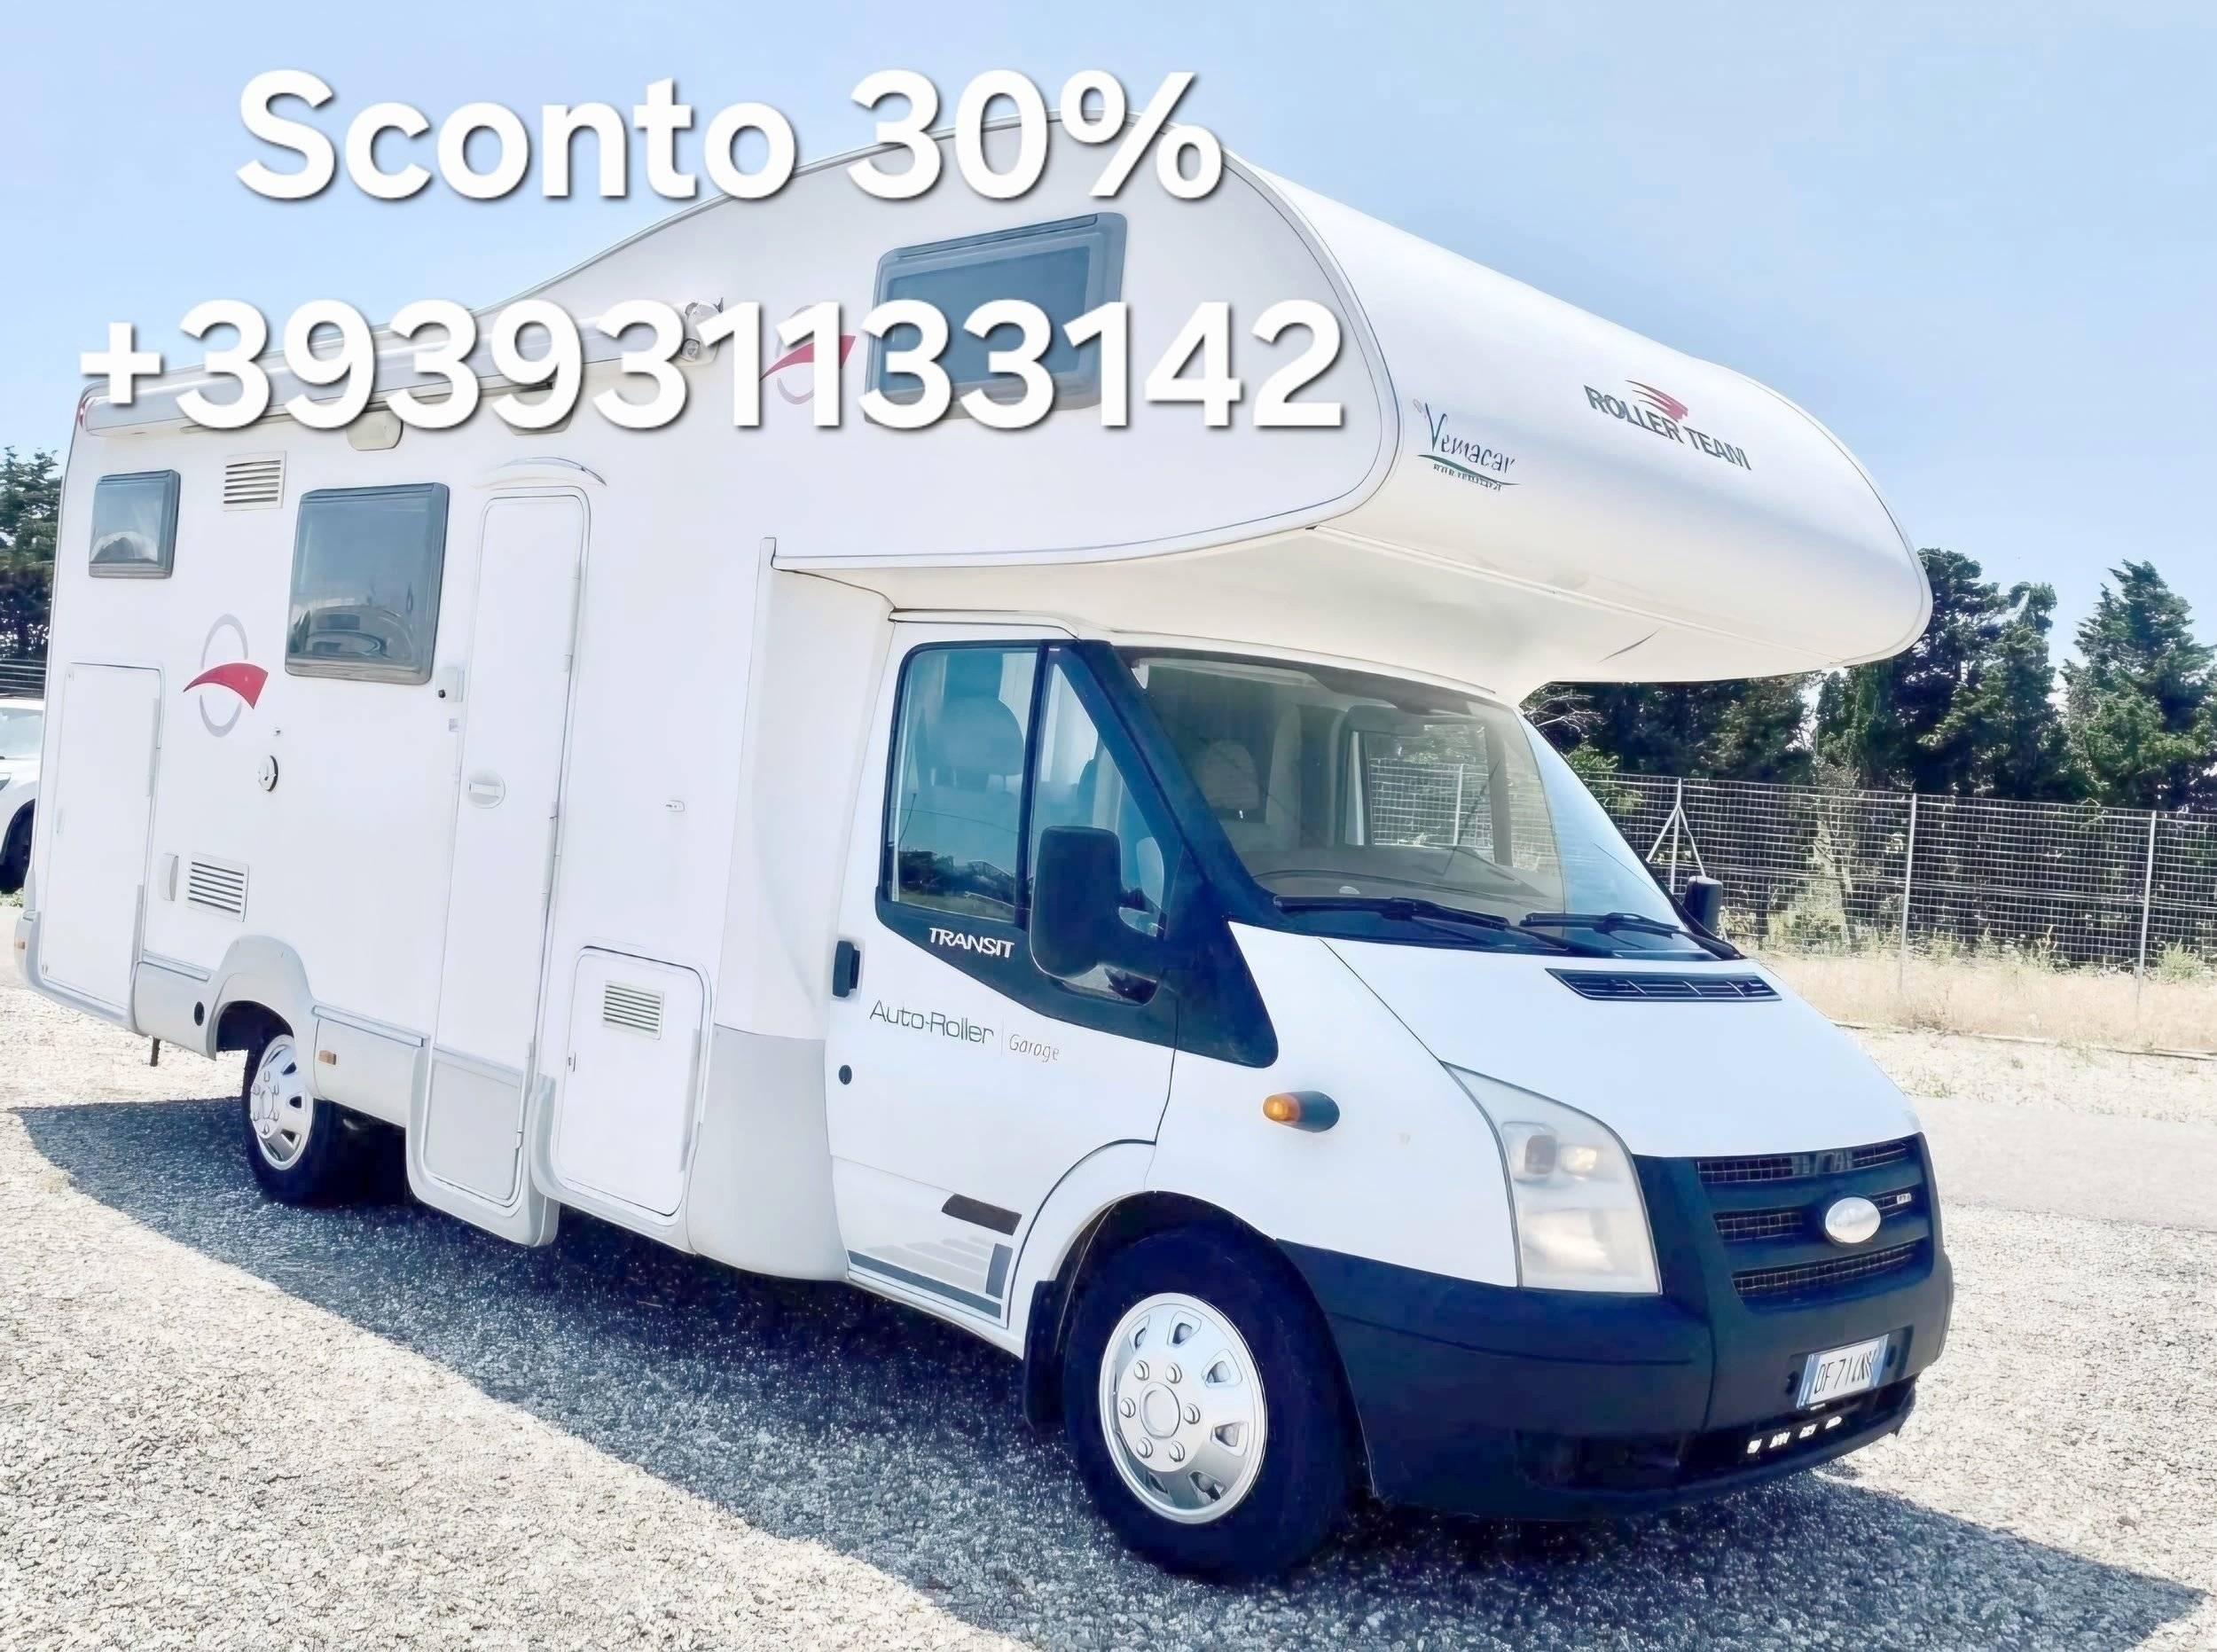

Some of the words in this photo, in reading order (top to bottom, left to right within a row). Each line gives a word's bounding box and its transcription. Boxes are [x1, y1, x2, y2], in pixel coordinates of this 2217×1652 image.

[1584, 385, 1684, 444] ROLLER
[1683, 426, 1752, 471] TEAM
[929, 928, 1015, 959] TRANSIT
[870, 999, 994, 1044] Auto-Roller
